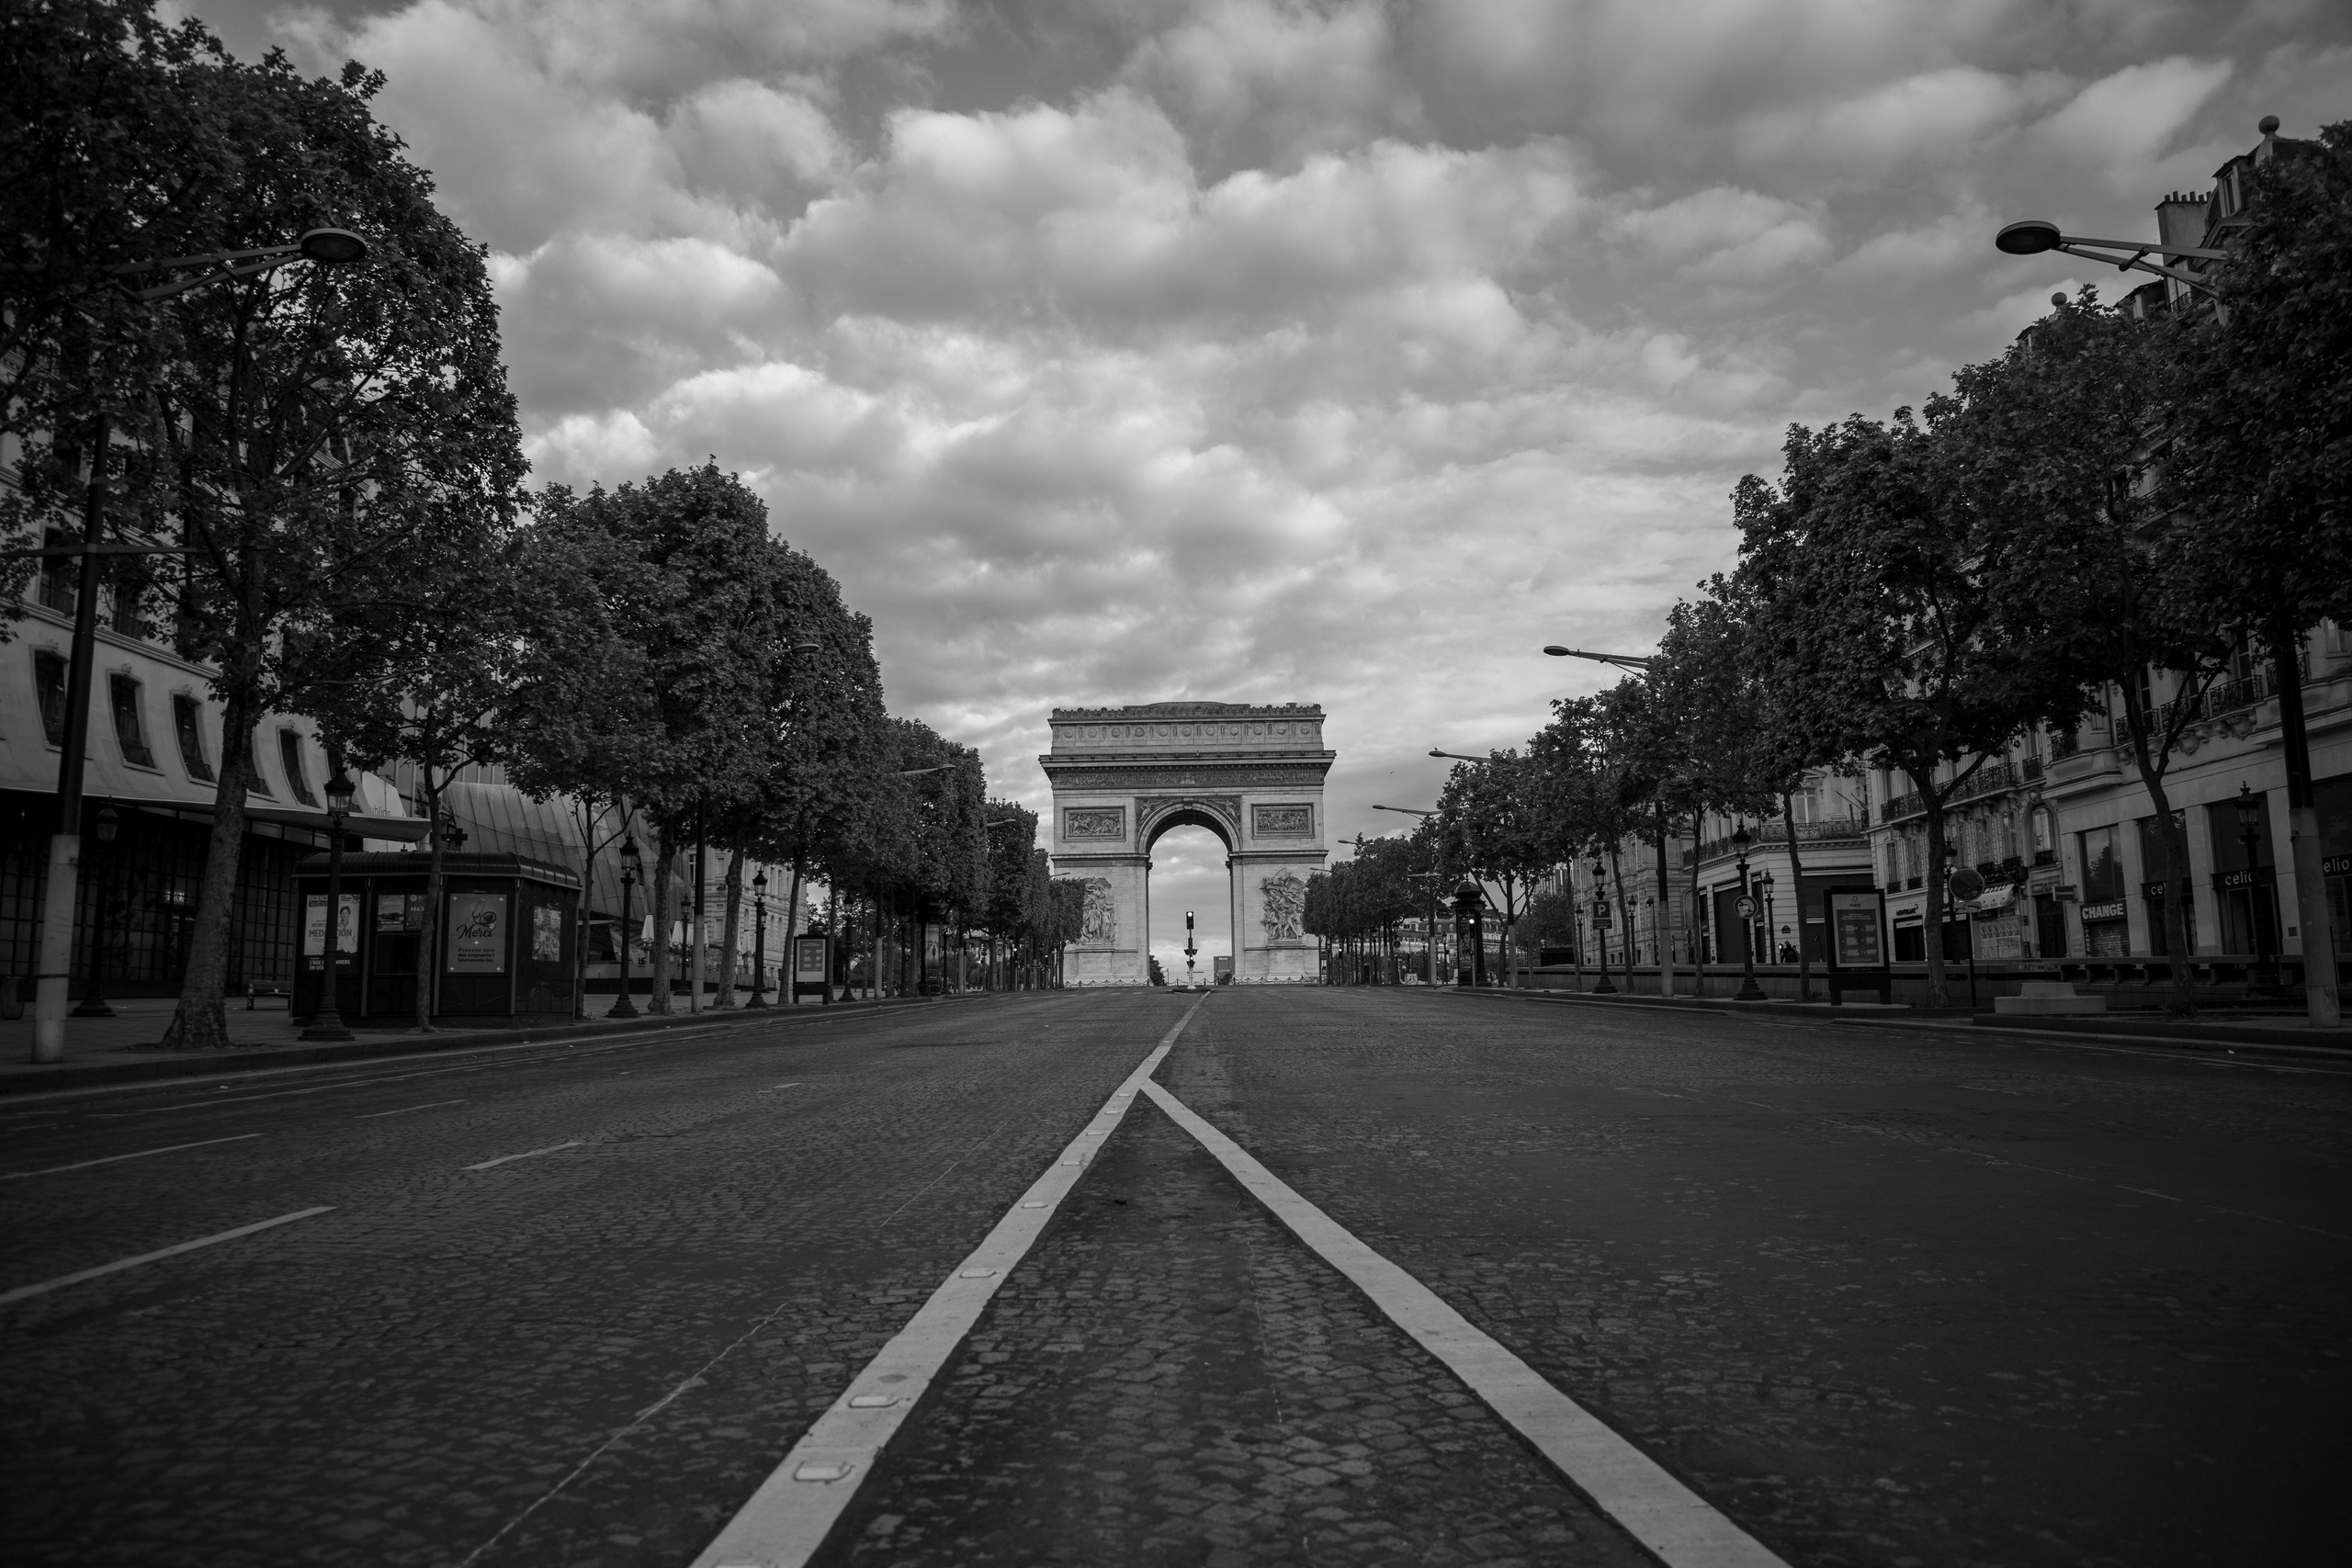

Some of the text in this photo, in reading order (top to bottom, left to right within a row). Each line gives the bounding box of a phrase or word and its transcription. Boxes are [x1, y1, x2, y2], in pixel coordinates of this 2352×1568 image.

[2324, 857, 2350, 873] elio
[1598, 904, 1607, 916] P
[2082, 903, 2124, 919] CHANGE
[456, 924, 494, 940] Merci
